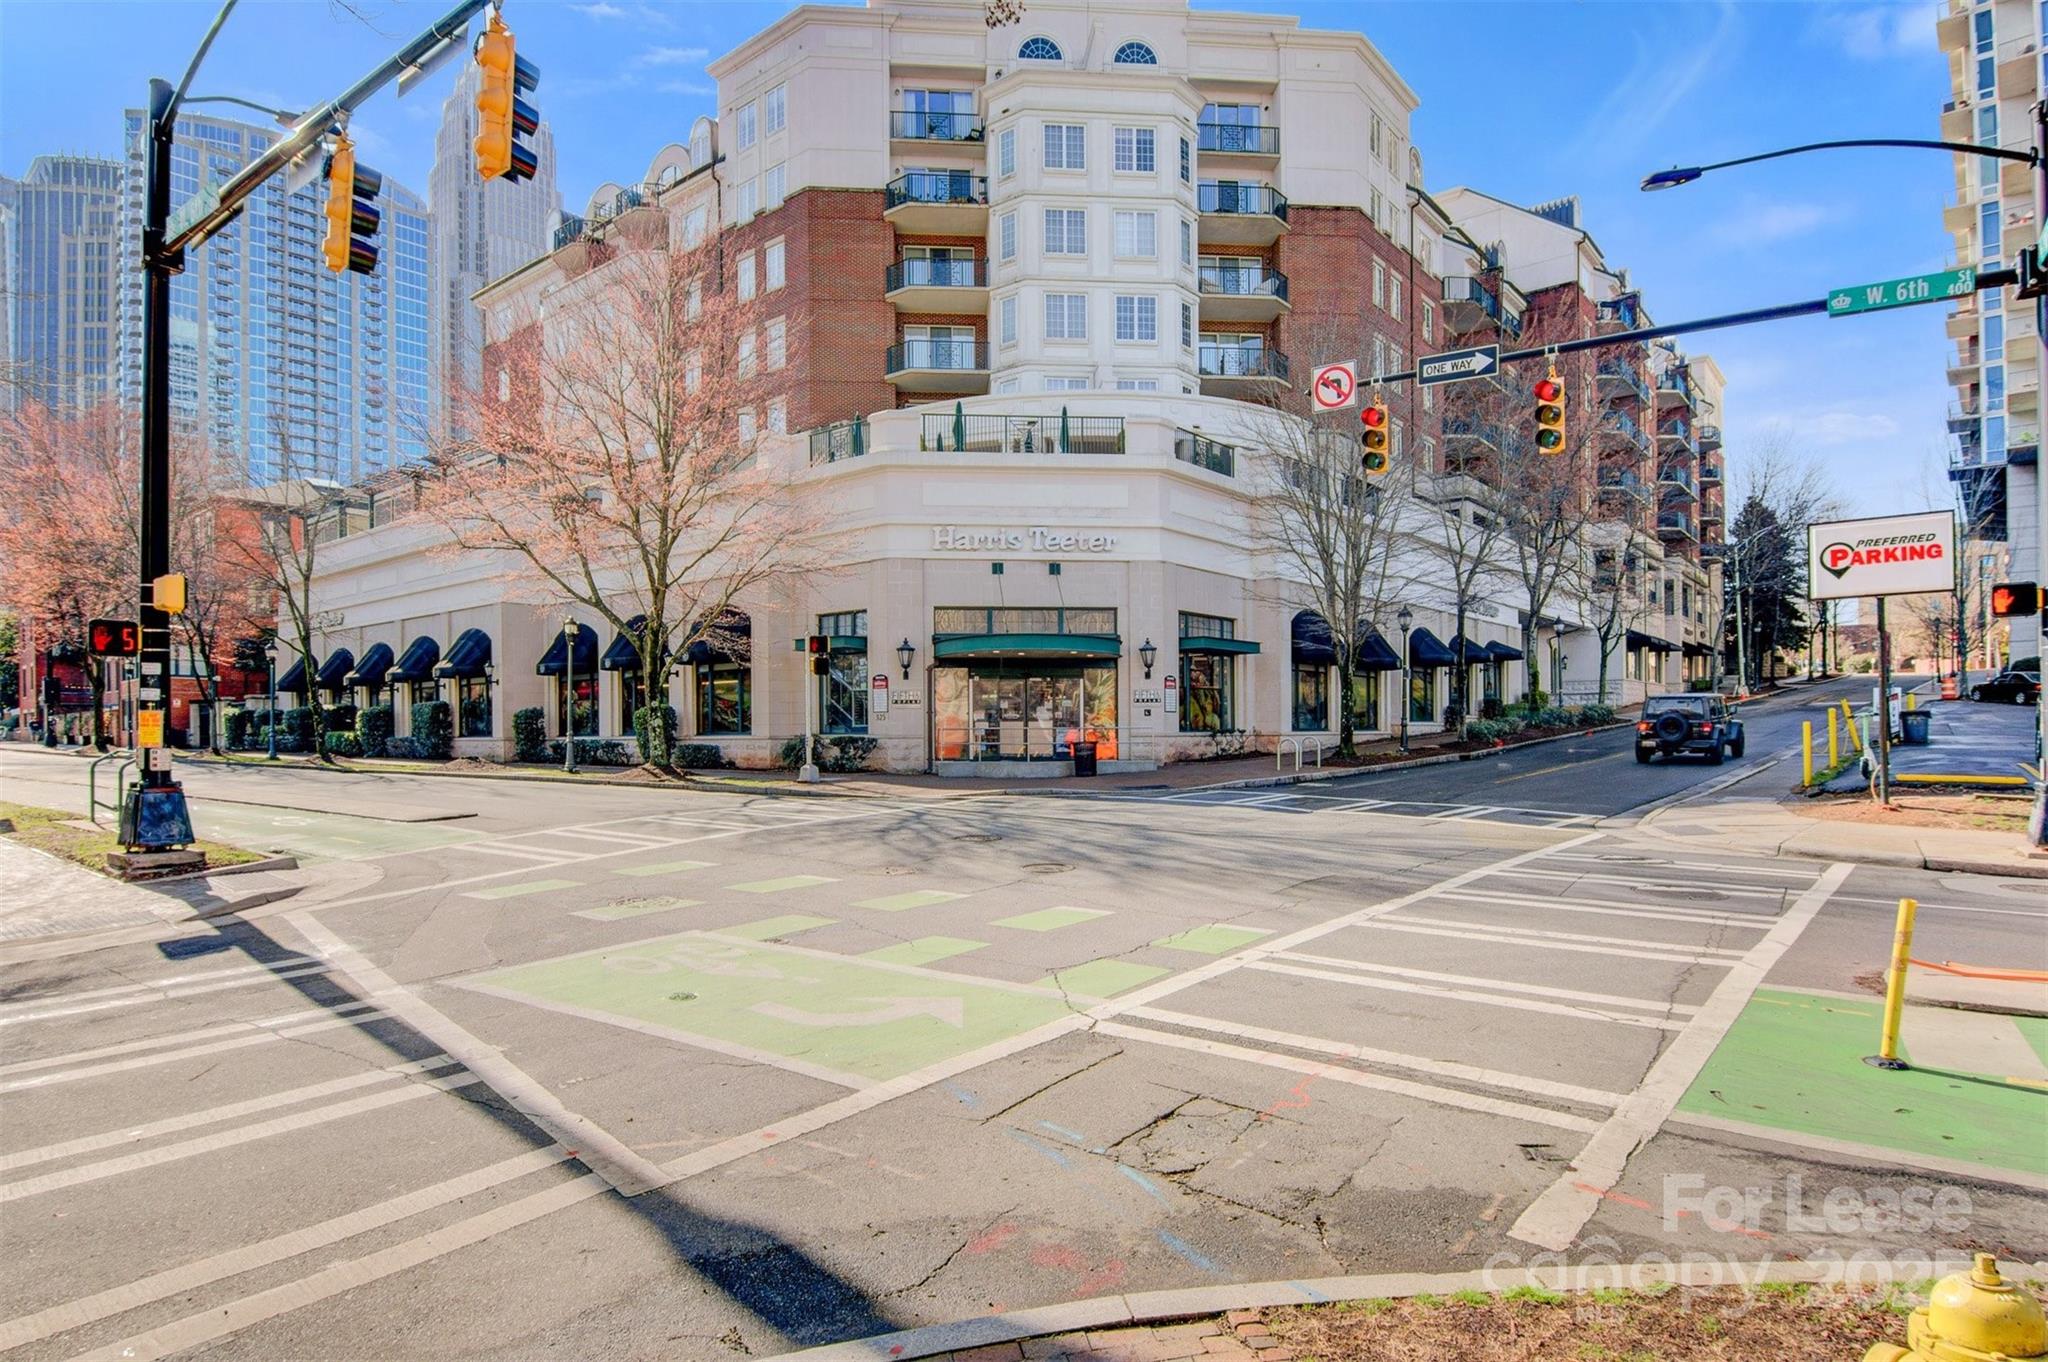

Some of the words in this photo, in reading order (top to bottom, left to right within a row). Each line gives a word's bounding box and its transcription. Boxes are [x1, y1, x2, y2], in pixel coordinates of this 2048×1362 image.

[1958, 269, 1972, 282] St
[1866, 285, 1888, 305] W.
[1896, 278, 1930, 301] 6th
[1947, 281, 1973, 296] 400
[1426, 363, 1447, 375] ONE
[1450, 358, 1473, 371] WAY
[932, 525, 1024, 551] Harris
[1028, 527, 1118, 553] Teeter
[1855, 533, 1936, 548] PREFERRED
[1830, 543, 1943, 567] PARKING
[122, 628, 135, 651] 5
